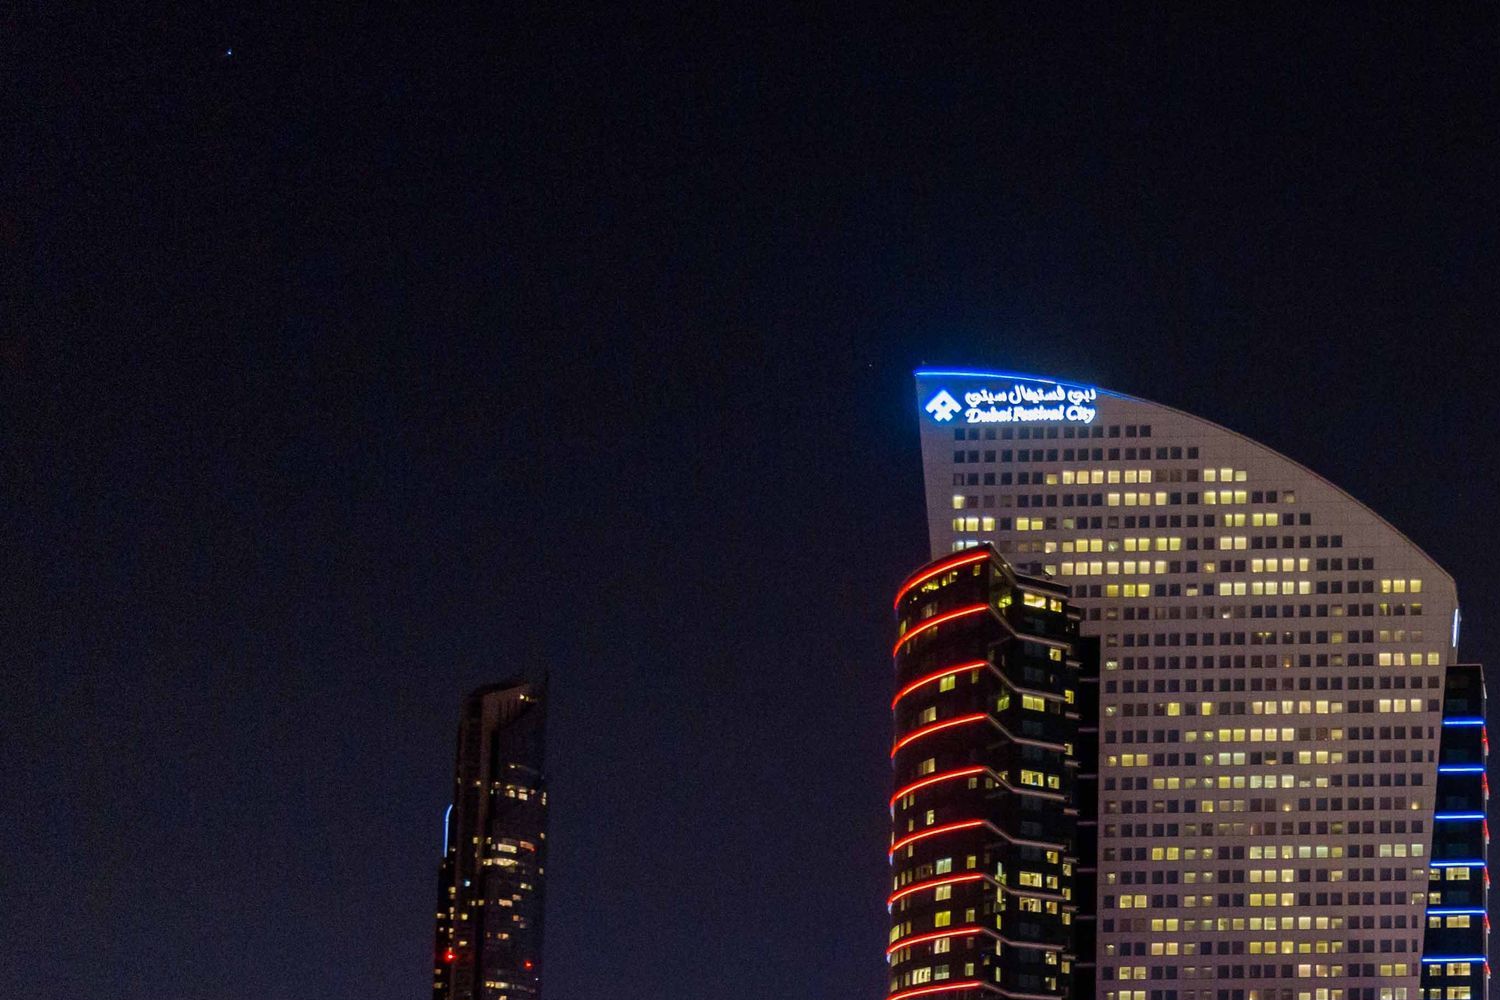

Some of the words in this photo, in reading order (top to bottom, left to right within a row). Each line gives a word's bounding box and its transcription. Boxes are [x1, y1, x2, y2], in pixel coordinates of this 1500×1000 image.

[965, 405, 1013, 423] Dubai
[1013, 405, 1065, 422] Festival
[1066, 405, 1096, 424] City
